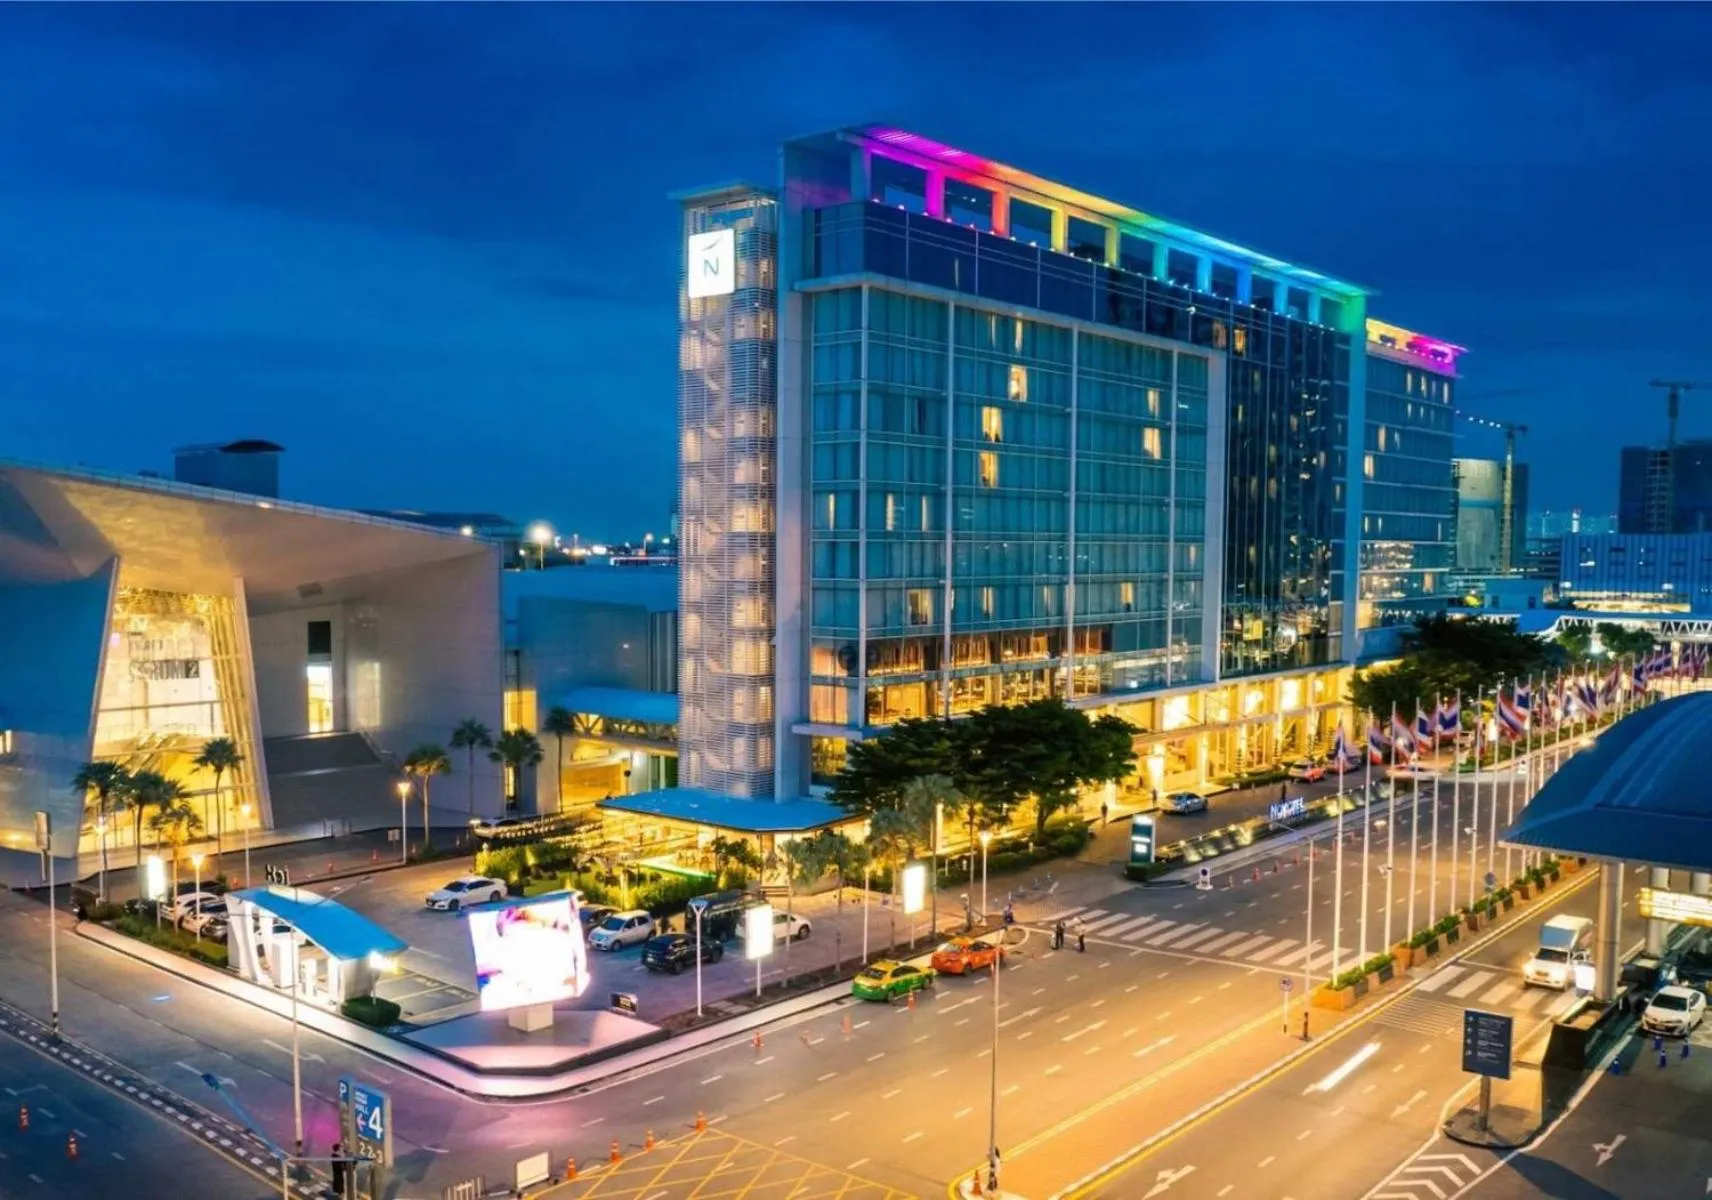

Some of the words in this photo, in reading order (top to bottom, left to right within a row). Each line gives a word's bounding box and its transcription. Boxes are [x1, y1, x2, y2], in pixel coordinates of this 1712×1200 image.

[703, 256, 720, 279] N
[339, 1082, 347, 1098] P
[368, 1106, 384, 1139] 4
